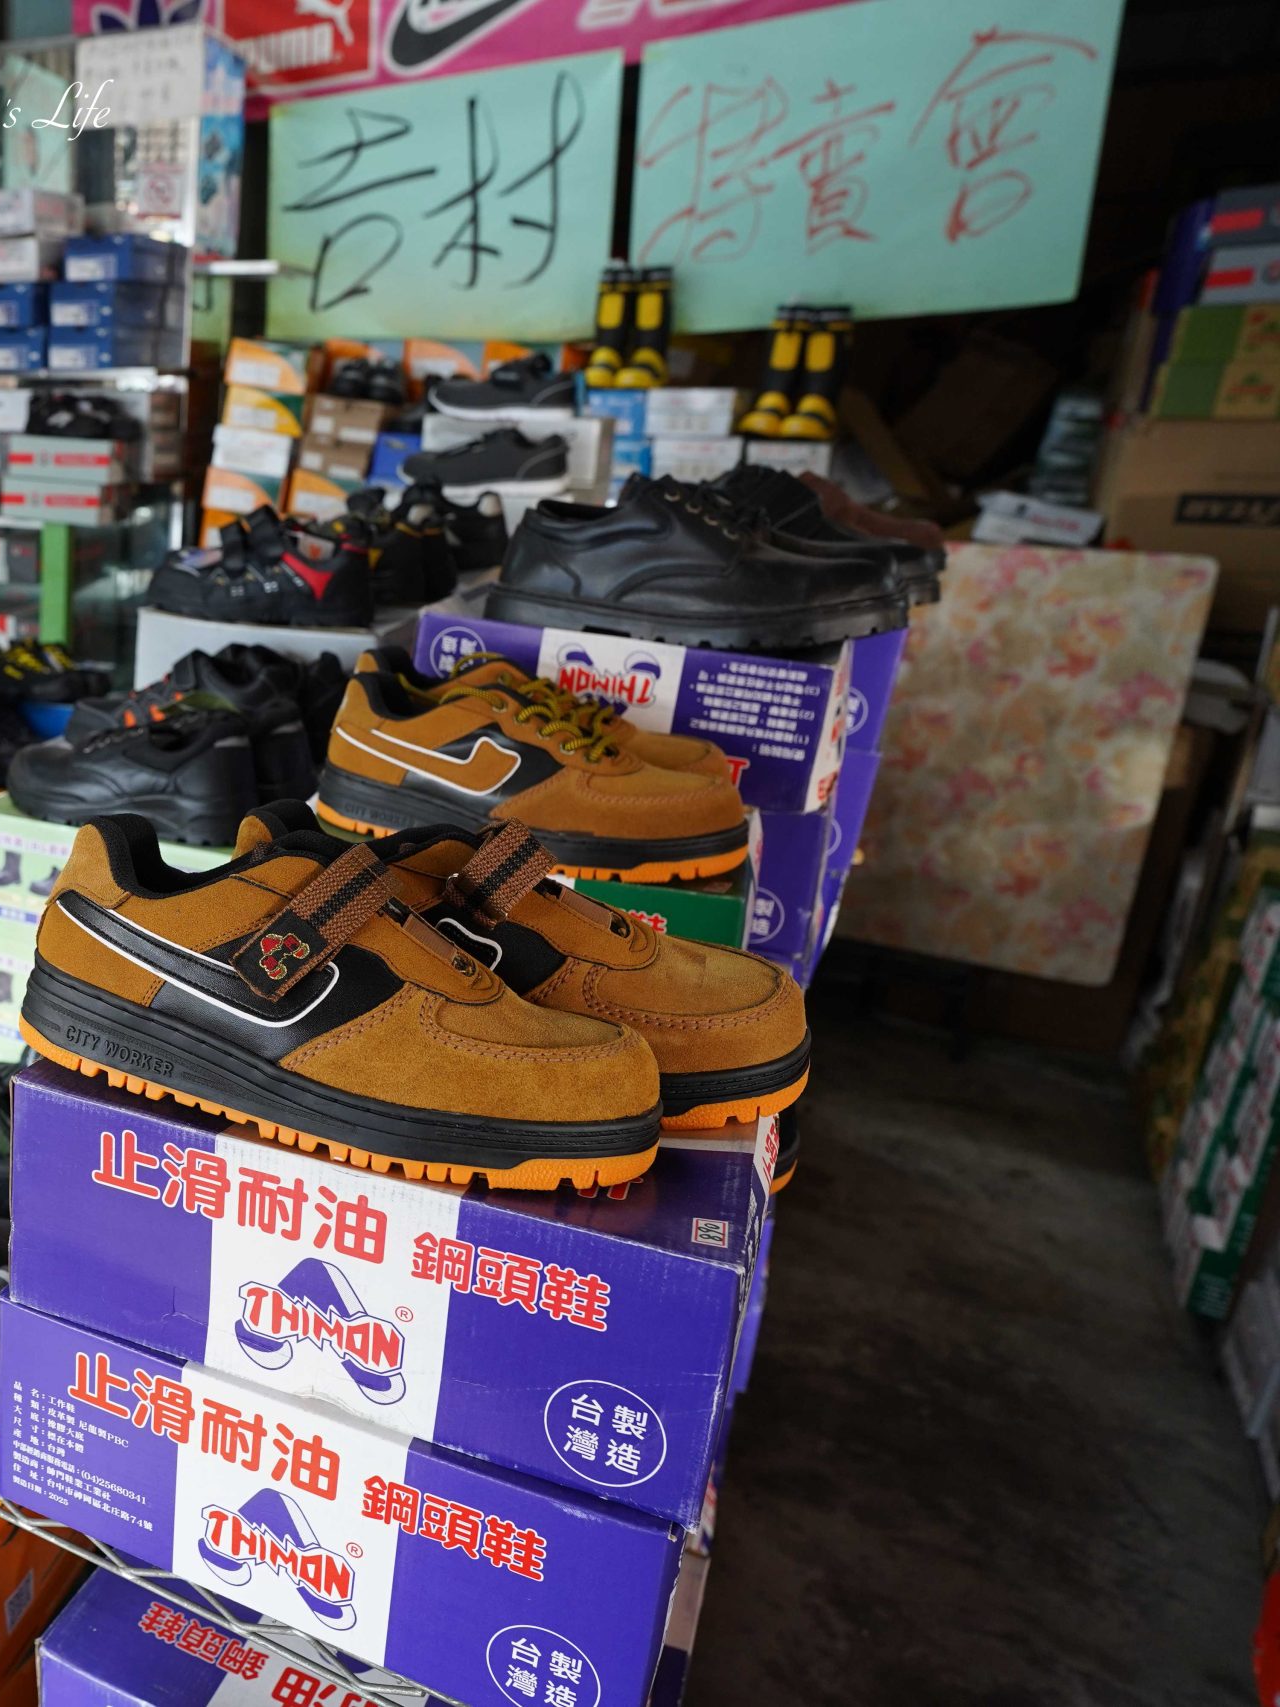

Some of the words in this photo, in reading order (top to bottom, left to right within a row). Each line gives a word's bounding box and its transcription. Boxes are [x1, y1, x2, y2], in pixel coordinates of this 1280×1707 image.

[559, 665, 655, 706] THIMON
[65, 1025, 101, 1051] CITY
[104, 1040, 175, 1079] WORKER
[90, 1129, 389, 1266] 止滑耐油
[410, 1230, 611, 1333] 鋼頭鞋
[697, 1222, 725, 1243] 890
[243, 1285, 404, 1371] THIMON
[68, 1351, 341, 1502] 止滑耐油
[360, 1474, 547, 1583] 鋼頭鞋
[206, 1509, 352, 1603] THIMON
[138, 1601, 270, 1681] 鋼頭鞋
